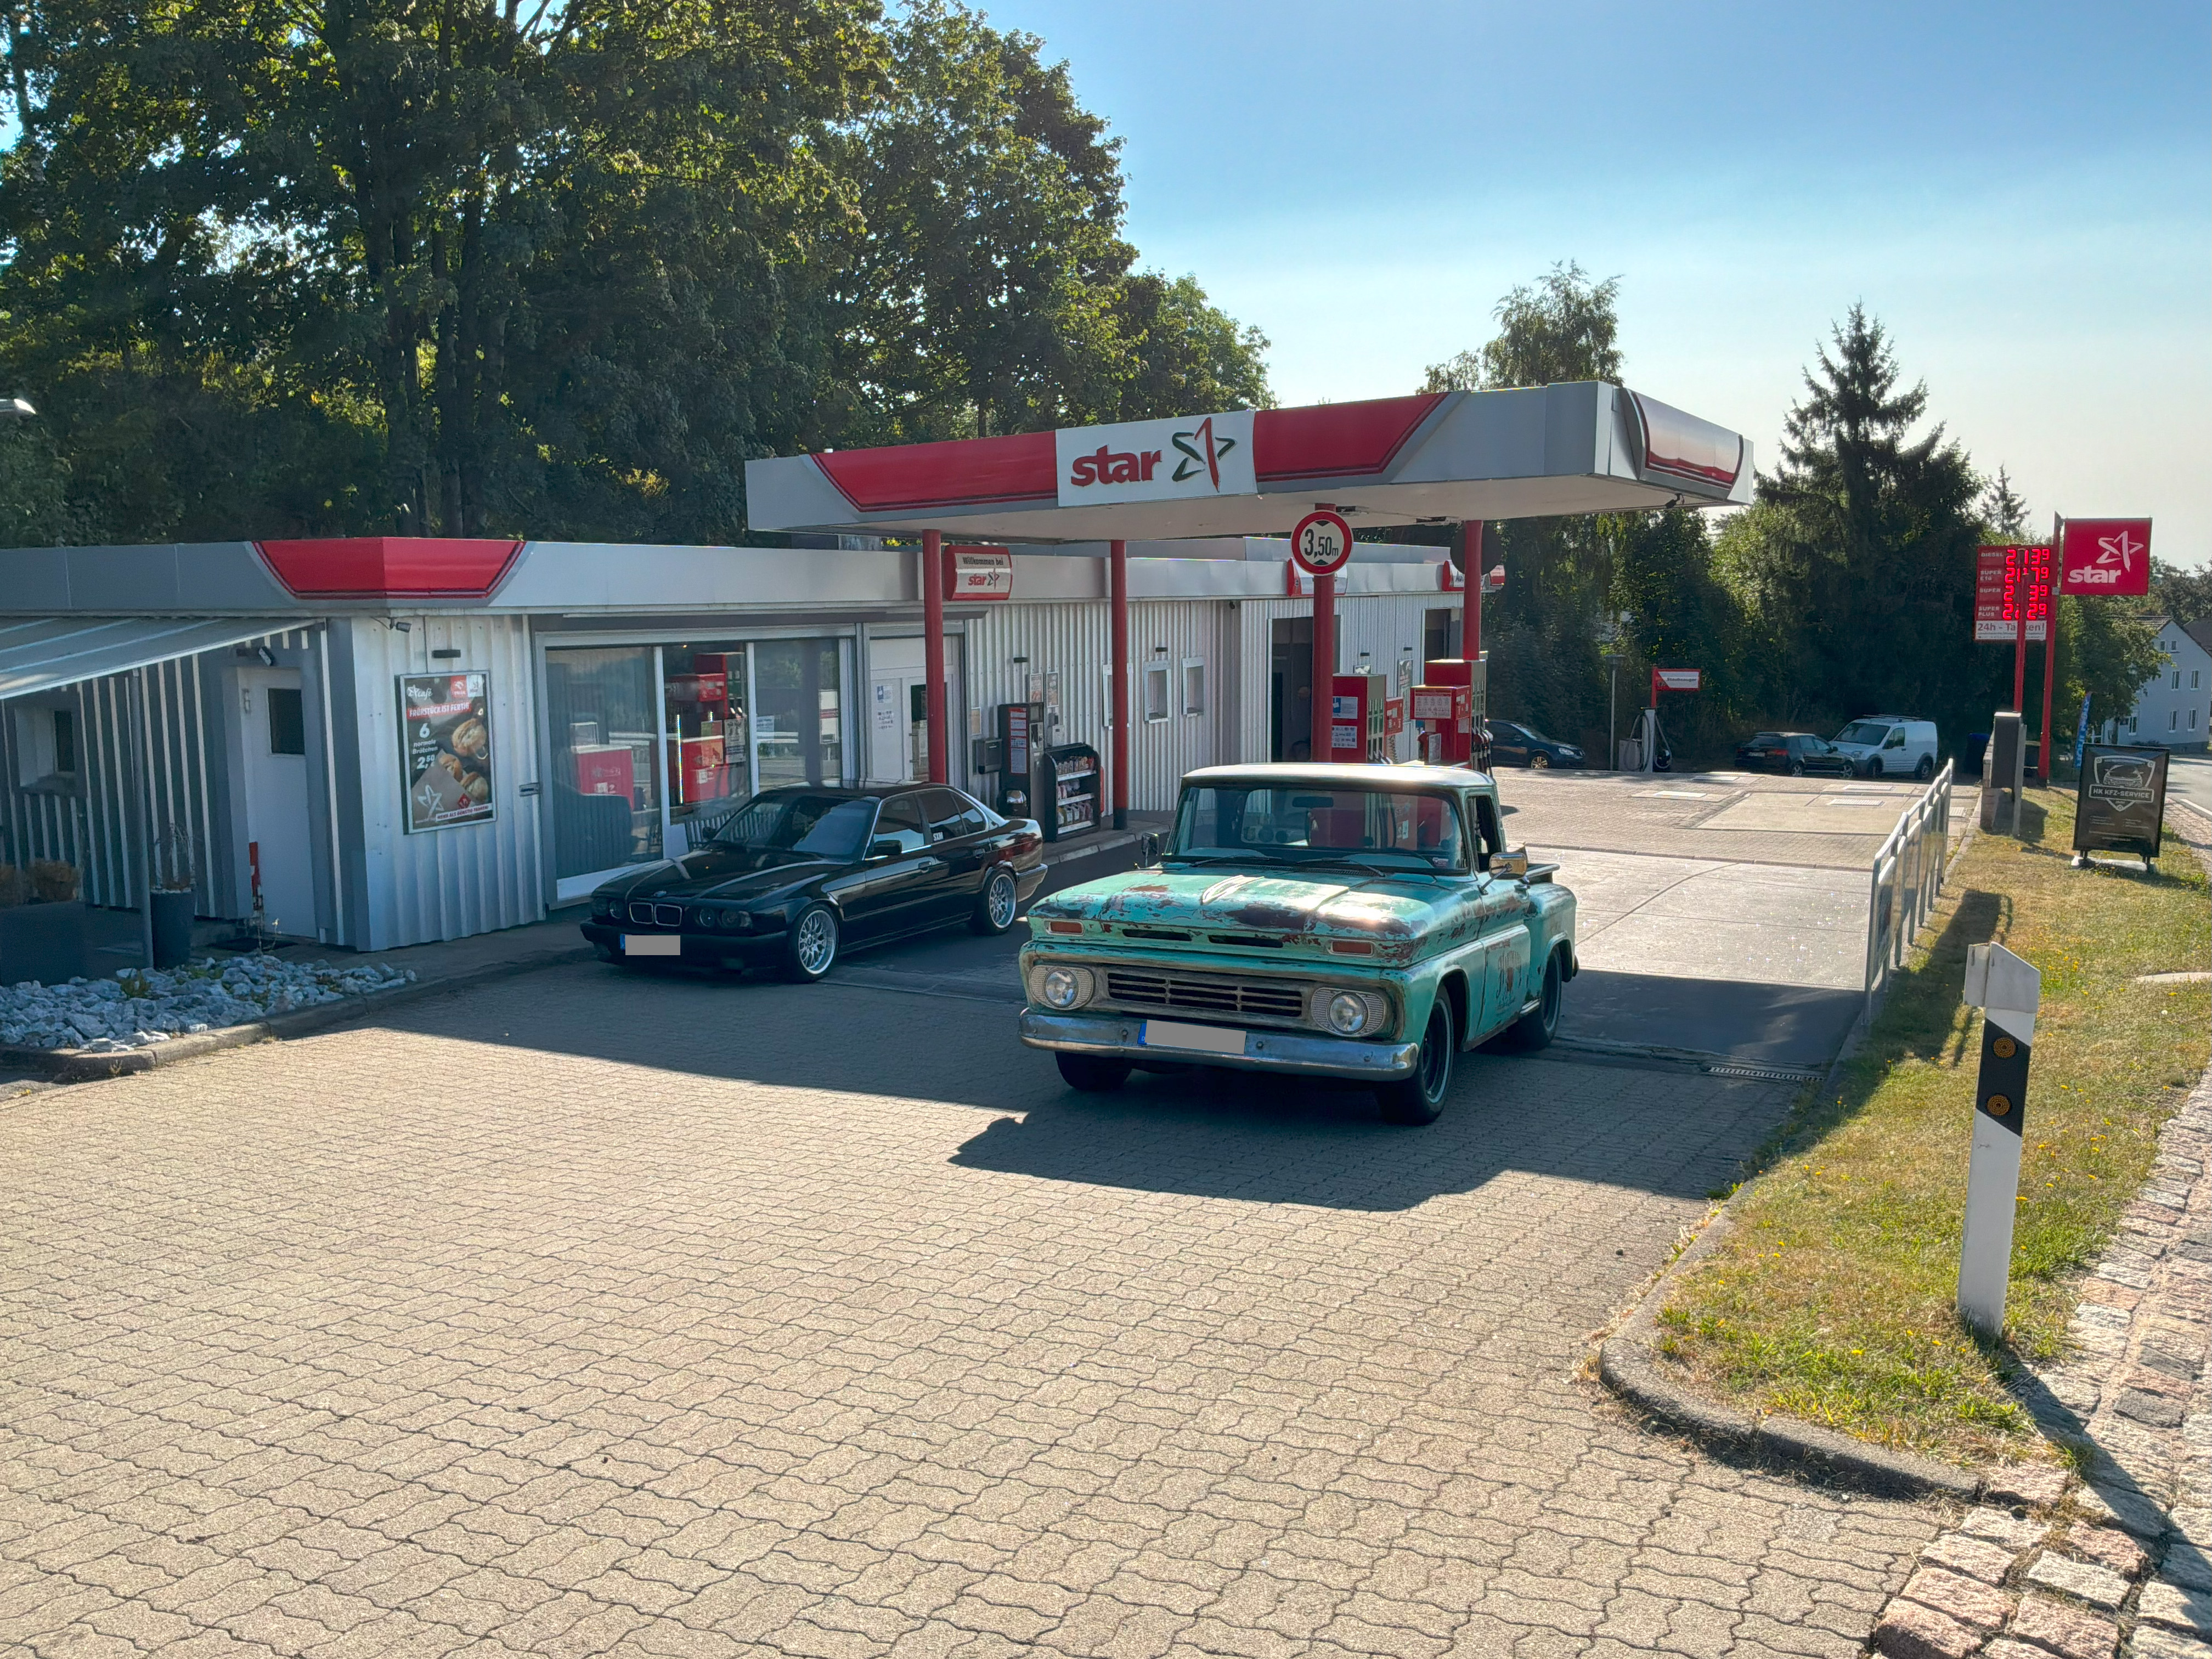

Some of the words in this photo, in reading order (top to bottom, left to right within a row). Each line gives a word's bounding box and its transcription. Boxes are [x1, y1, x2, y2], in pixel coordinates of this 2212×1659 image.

[1071, 444, 1162, 487] star
[963, 557, 995, 565] Willkommen
[968, 573, 986, 585] star
[2068, 565, 2121, 583] star
[1977, 623, 1996, 631] 24h
[2006, 623, 2045, 631] Taken!
[418, 687, 433, 700] café
[409, 704, 441, 716] FRÜHSTÜCK
[450, 702, 470, 712] FERTIG
[420, 723, 430, 738] 6
[413, 738, 436, 747] normale
[413, 746, 438, 754] Brötchen
[2104, 790, 2150, 798] KFZ-SERVICE
